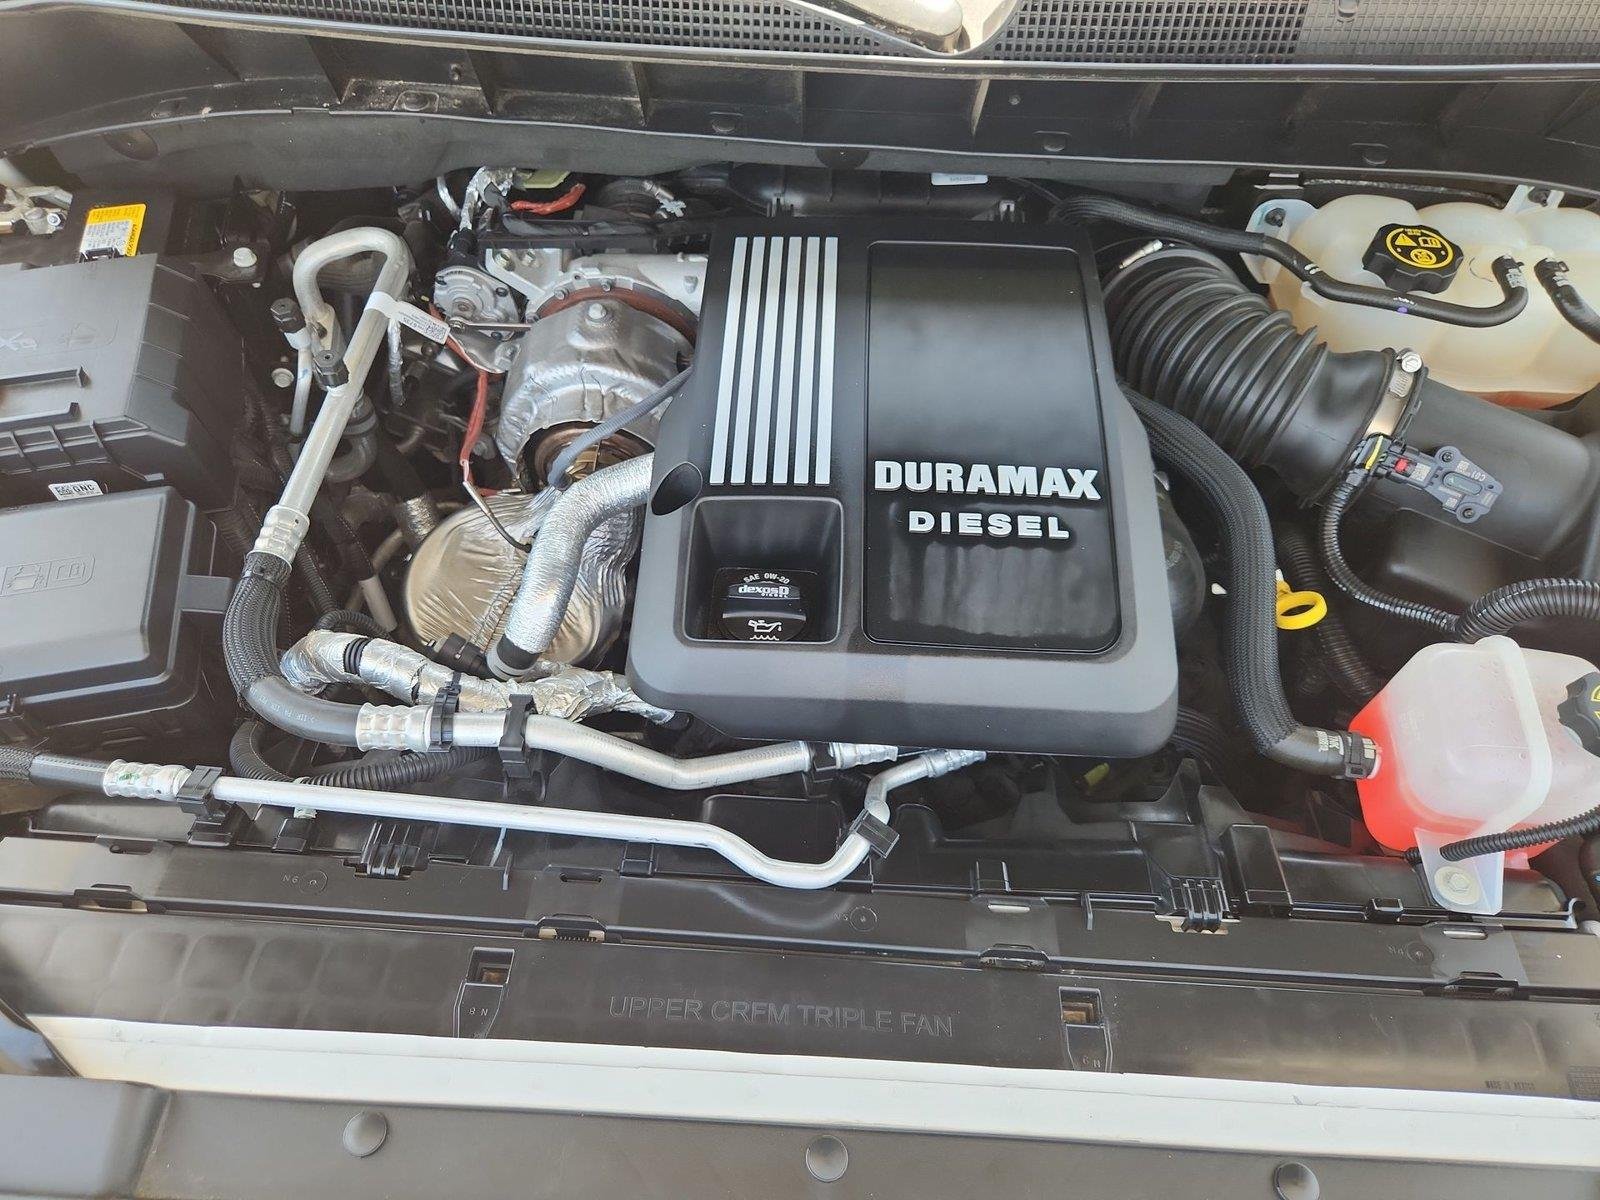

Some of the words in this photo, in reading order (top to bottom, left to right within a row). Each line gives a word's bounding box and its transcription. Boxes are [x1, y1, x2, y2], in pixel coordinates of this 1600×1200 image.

[874, 460, 1101, 500] DURAMAX
[908, 510, 1069, 539] DIESEL
[743, 573, 760, 583] SAE
[764, 572, 790, 584] 0W-20
[608, 996, 703, 1022] UPPER
[711, 1000, 791, 1025] CRFM
[796, 1004, 893, 1032] TRIPLE
[900, 1011, 953, 1037] FAN
